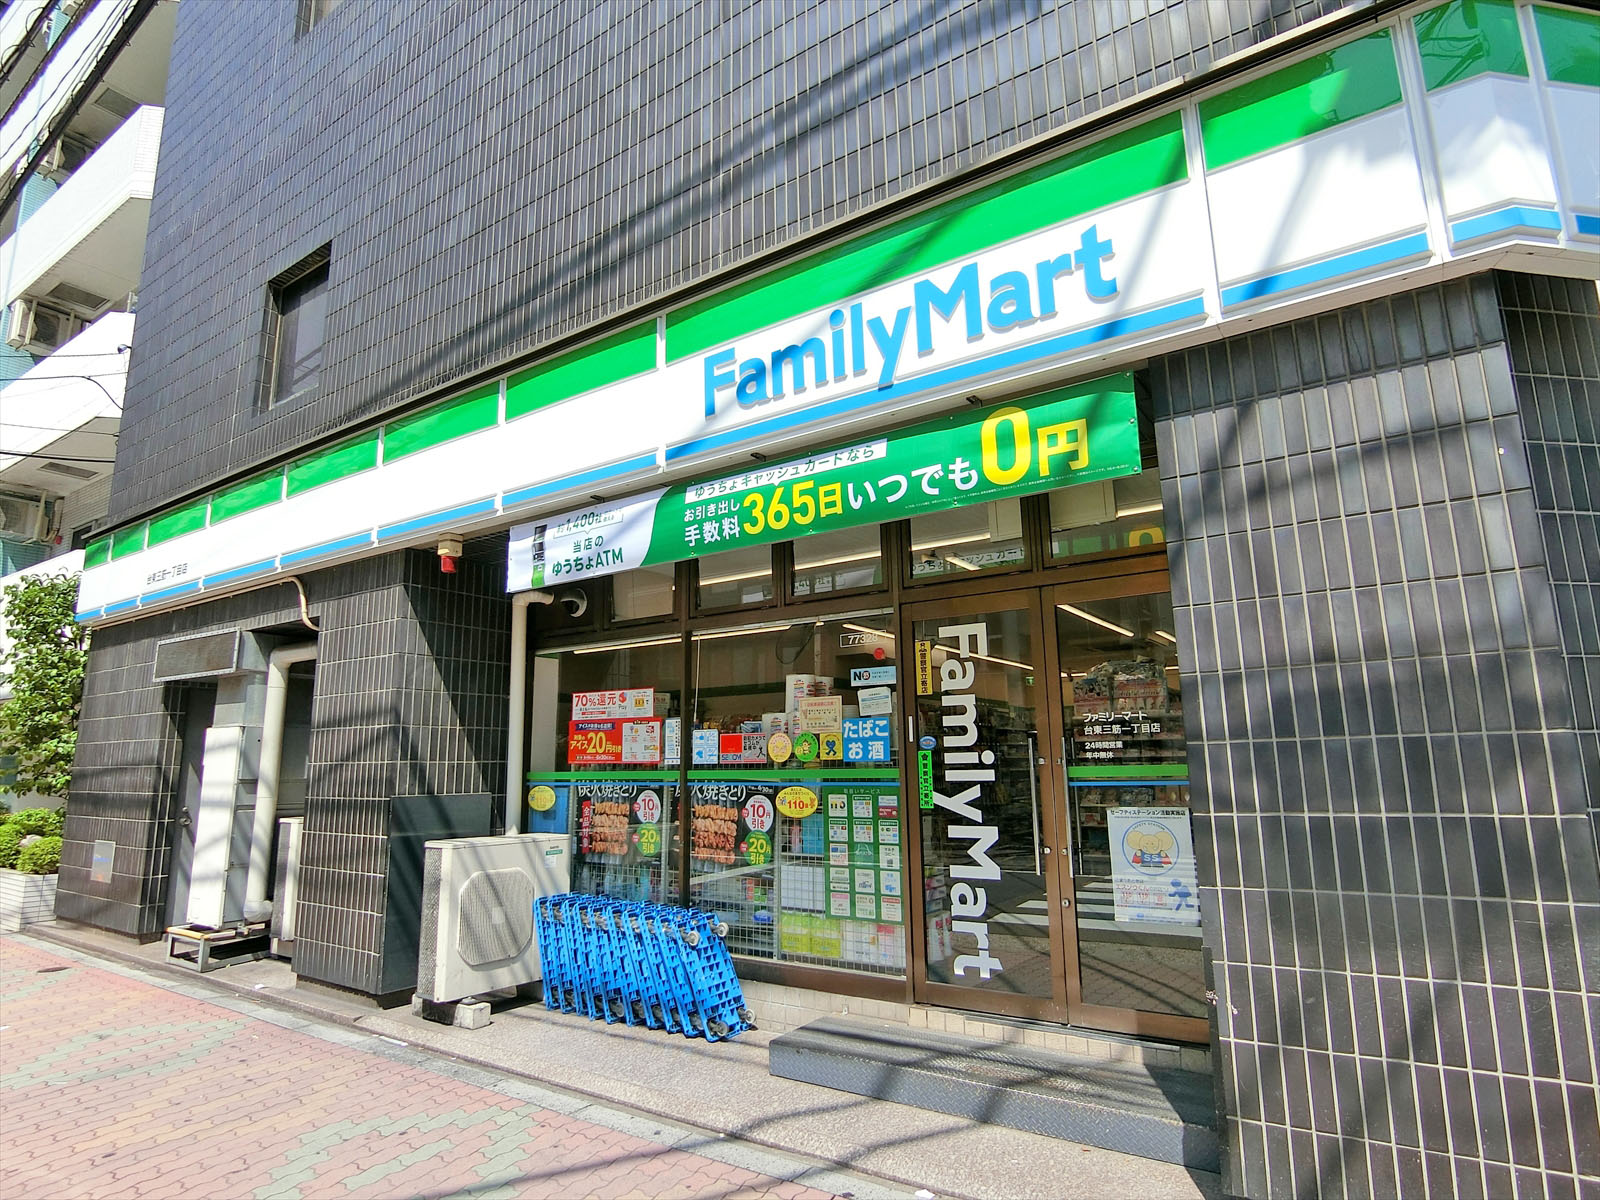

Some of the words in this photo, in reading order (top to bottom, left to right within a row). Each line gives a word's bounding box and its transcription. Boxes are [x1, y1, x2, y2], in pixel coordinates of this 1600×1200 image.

[704, 224, 1119, 417] FamilyMart
[694, 445, 875, 498] ゆうちょキャッシュカードなら
[684, 499, 740, 522] お引き出し
[684, 515, 740, 547] 手数料
[573, 535, 604, 553] 当店の
[552, 547, 624, 576] ゆうちょATM
[1082, 710, 1148, 723] ファミリーマート
[844, 719, 889, 738] たばこ
[1083, 723, 1161, 736] 台東三筋一丁目店
[848, 741, 886, 760] お酒
[1085, 740, 1123, 750] 24時間営業
[1085, 751, 1114, 759] 年中無休
[933, 622, 1003, 980] FamilyMart
[1143, 854, 1160, 862] SS
